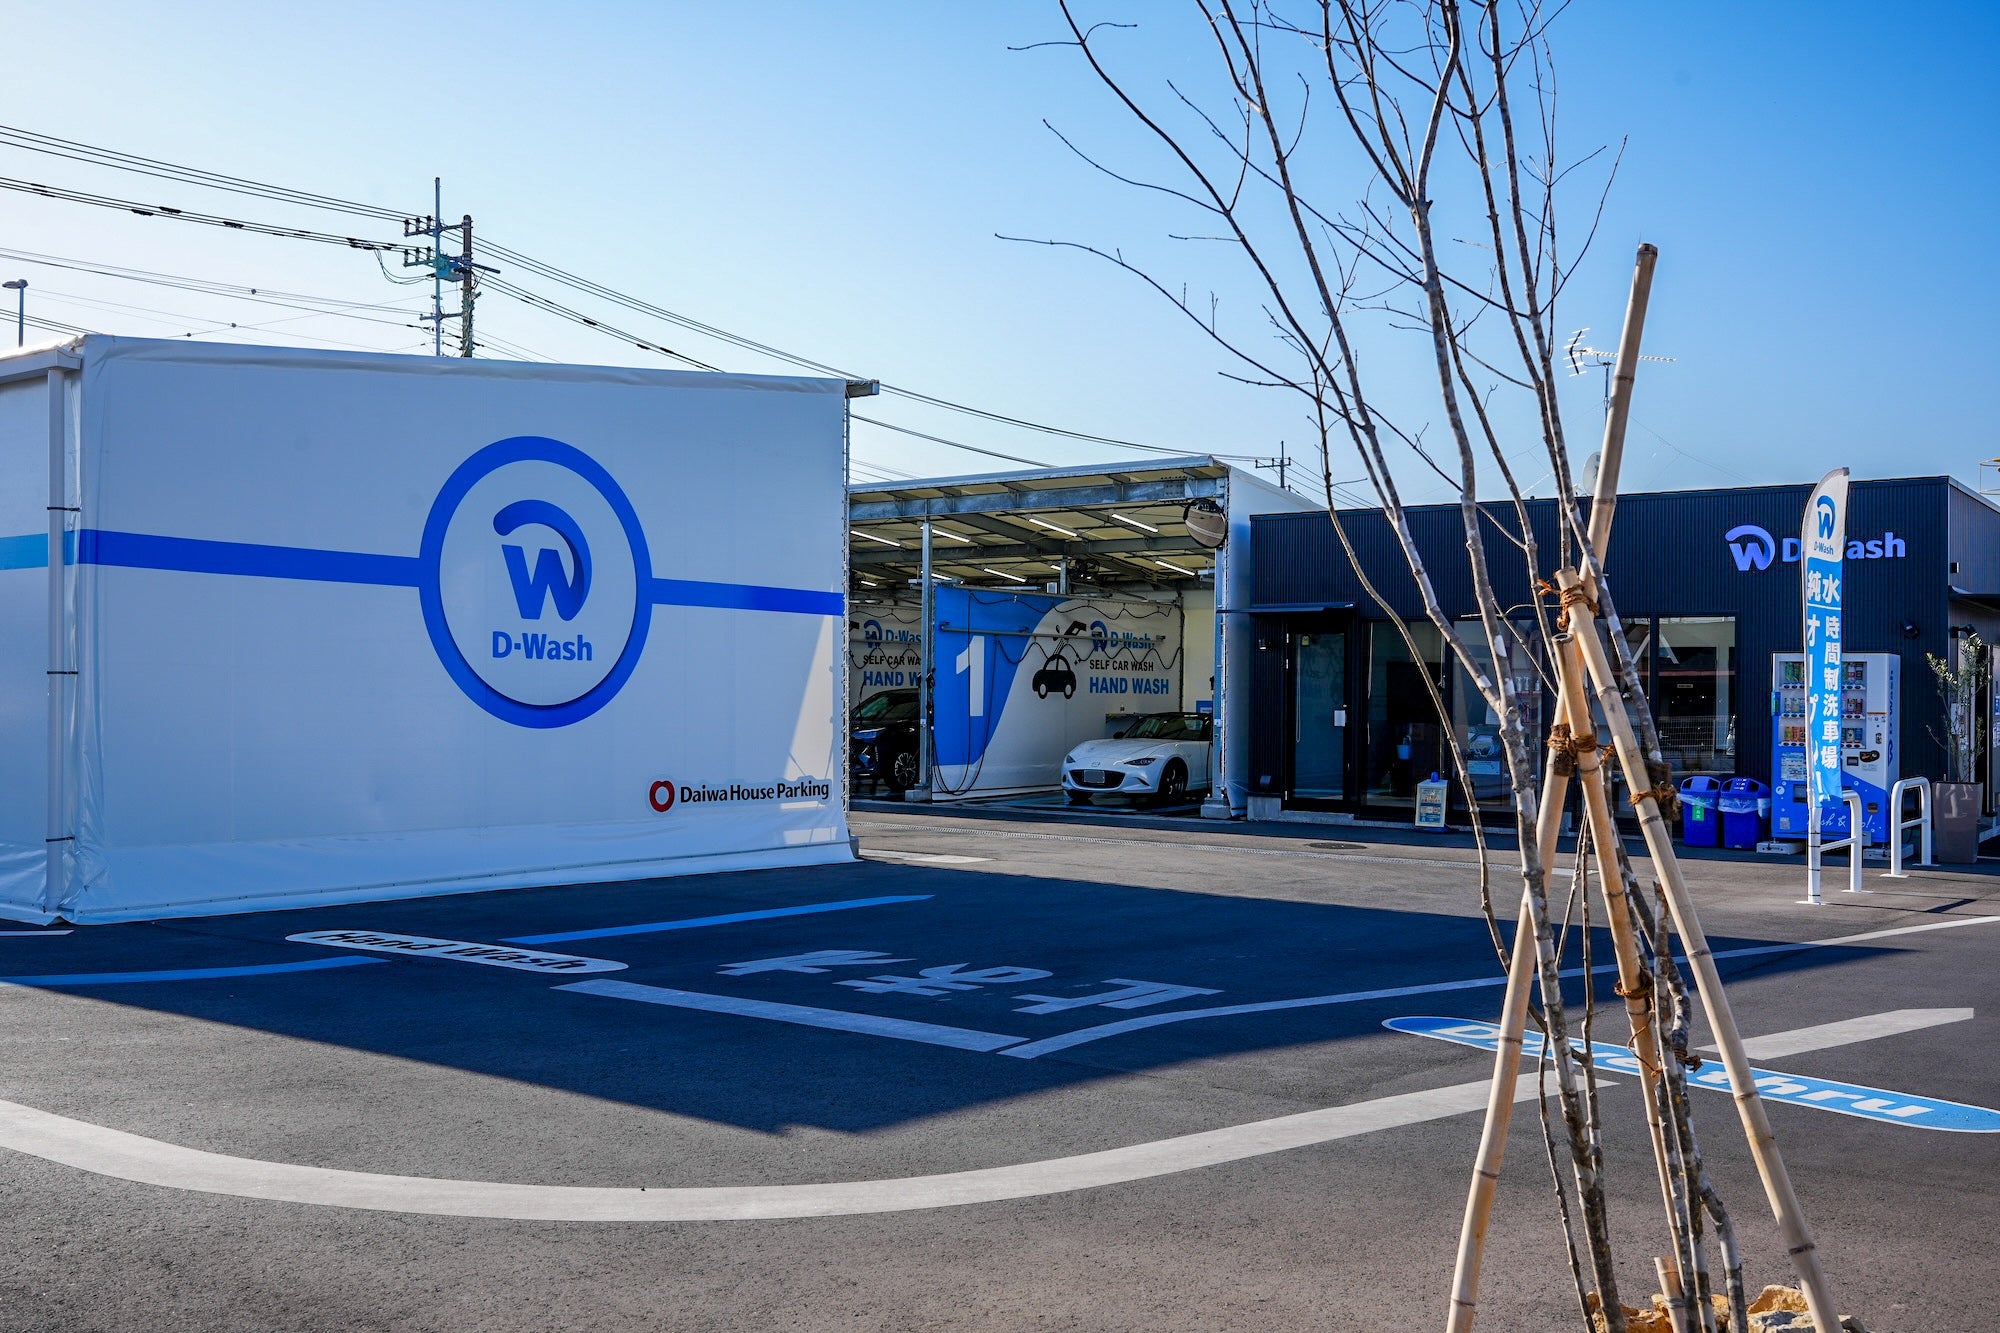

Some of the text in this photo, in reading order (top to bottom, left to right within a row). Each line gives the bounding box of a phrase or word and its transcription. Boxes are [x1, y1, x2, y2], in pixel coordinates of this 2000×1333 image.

[1782, 531, 1906, 563] Dash
[1814, 541, 1834, 556] D-Wash
[492, 630, 593, 662] D-Wash
[885, 629, 922, 643] D-Was
[863, 654, 922, 666] SELF CAR WA
[1089, 659, 1154, 672] SELF CAR WASH
[863, 671, 905, 687] HAND
[956, 635, 985, 717] 1
[1089, 676, 1169, 695] HAND WASH
[1821, 615, 1841, 769] 時間制洗車場
[680, 780, 829, 803] Daiwa House Parking
[311, 932, 587, 970] Hand Wash
[715, 949, 1225, 1015] 止まれ
